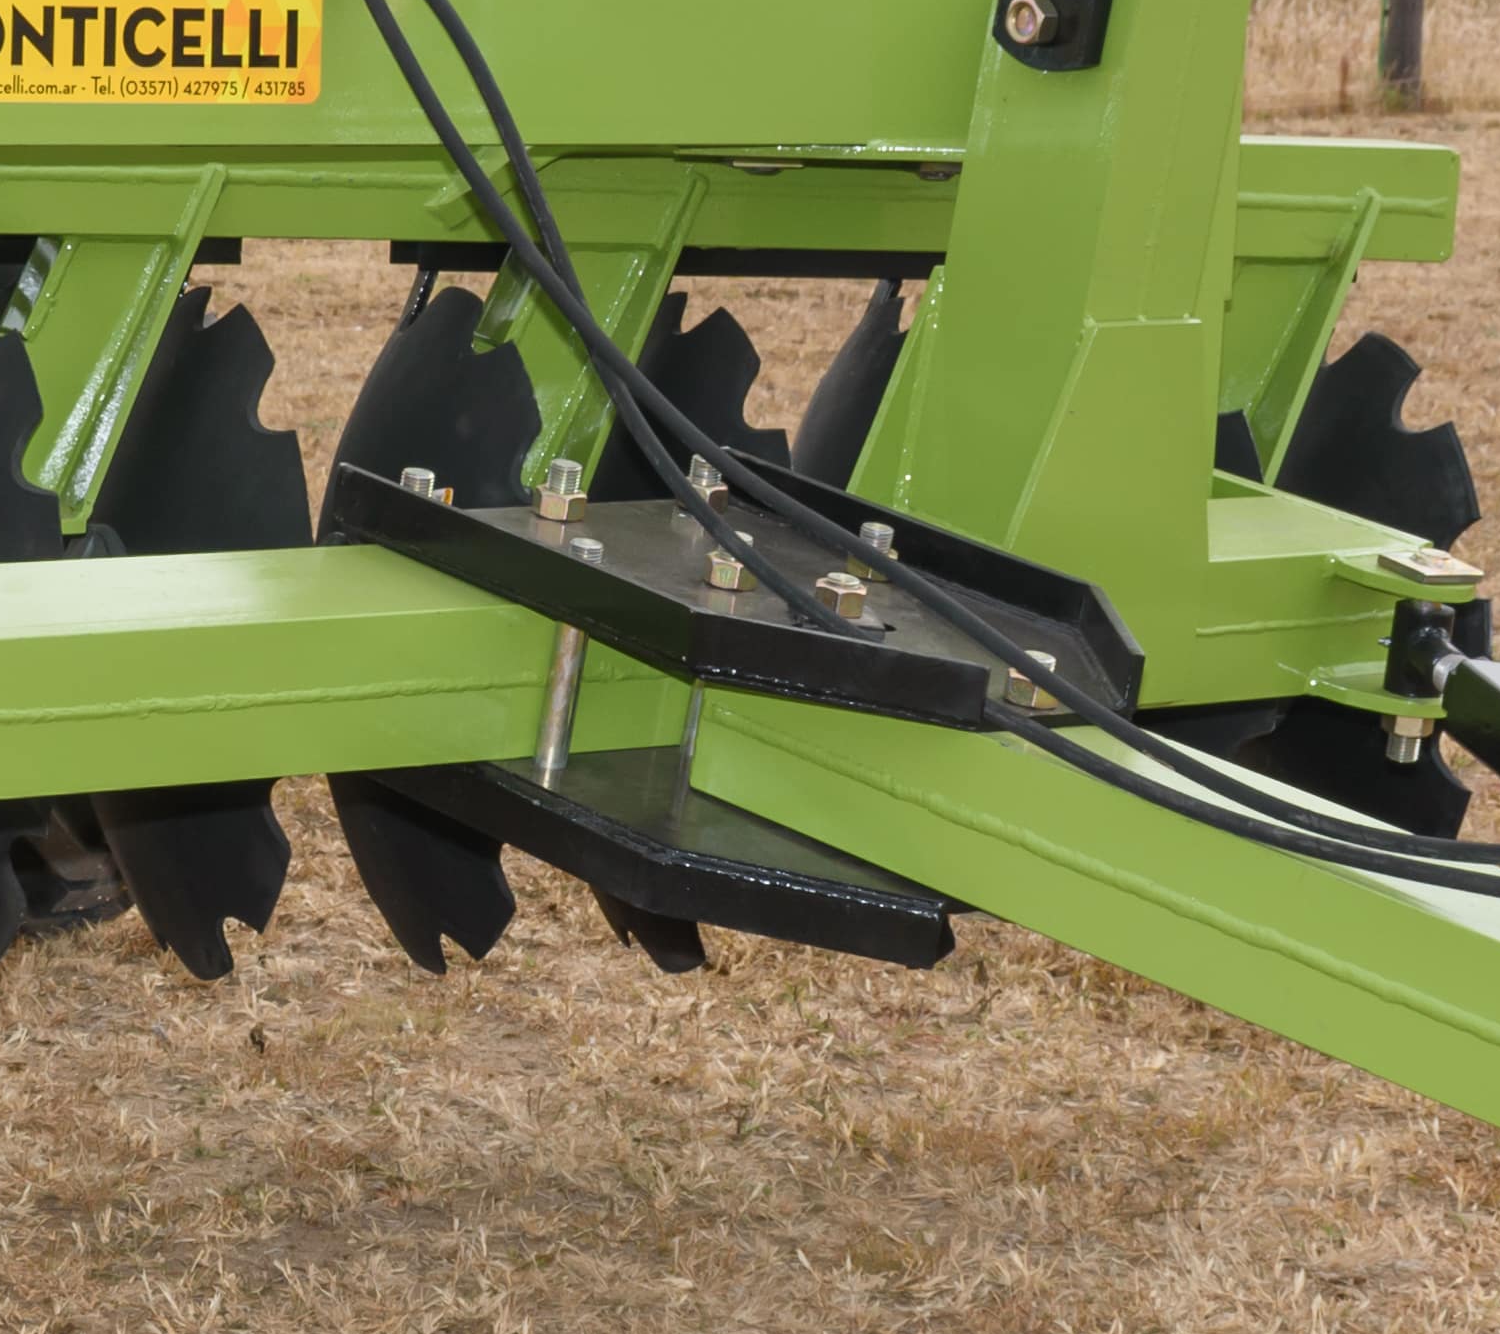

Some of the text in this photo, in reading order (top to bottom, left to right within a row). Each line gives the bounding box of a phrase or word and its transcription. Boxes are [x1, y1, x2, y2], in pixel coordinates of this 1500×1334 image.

[91, 76, 115, 96] Tel.
[119, 76, 179, 99] (03571)
[183, 80, 238, 96] 427975
[241, 76, 250, 99] /
[254, 80, 305, 97] 431785
